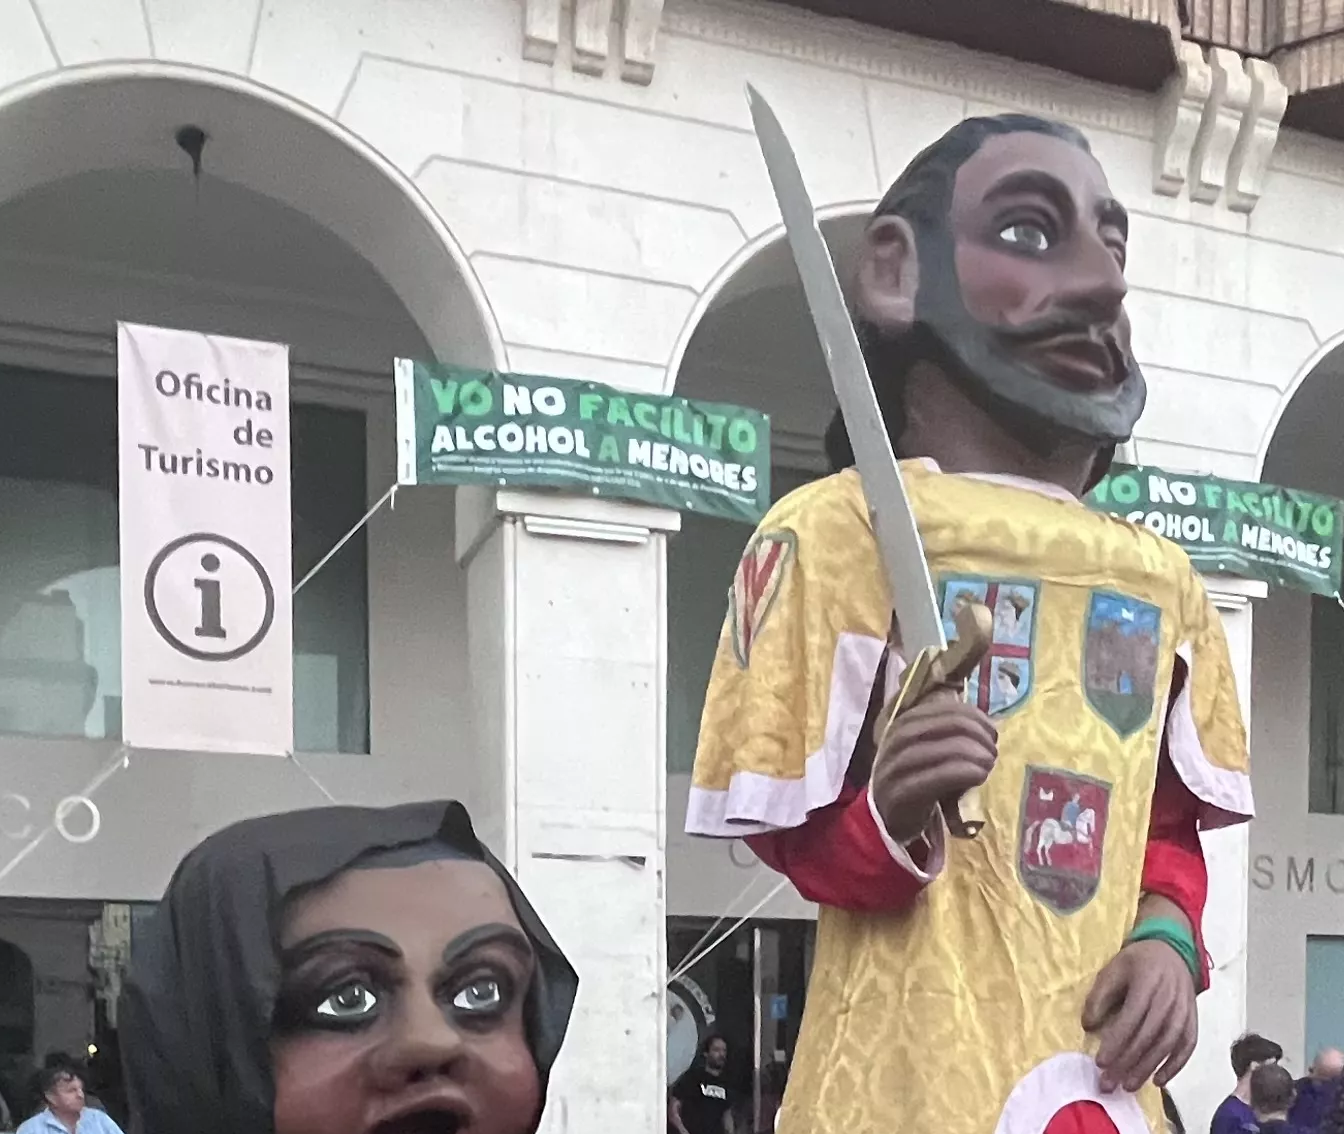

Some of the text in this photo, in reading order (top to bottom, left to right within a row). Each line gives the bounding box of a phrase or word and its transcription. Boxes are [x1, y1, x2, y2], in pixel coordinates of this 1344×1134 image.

[156, 370, 272, 411] Oficina
[233, 419, 273, 448] de
[430, 379, 757, 453] YO NO FACILITO
[138, 444, 274, 485] Turismo
[431, 422, 590, 458] ALCOHOL
[598, 435, 621, 463] A
[628, 439, 758, 492] MENORES
[1148, 475, 1197, 506] NO
[1203, 484, 1335, 536] FACILITO
[1222, 520, 1239, 542] A
[1241, 523, 1332, 569] MENORES
